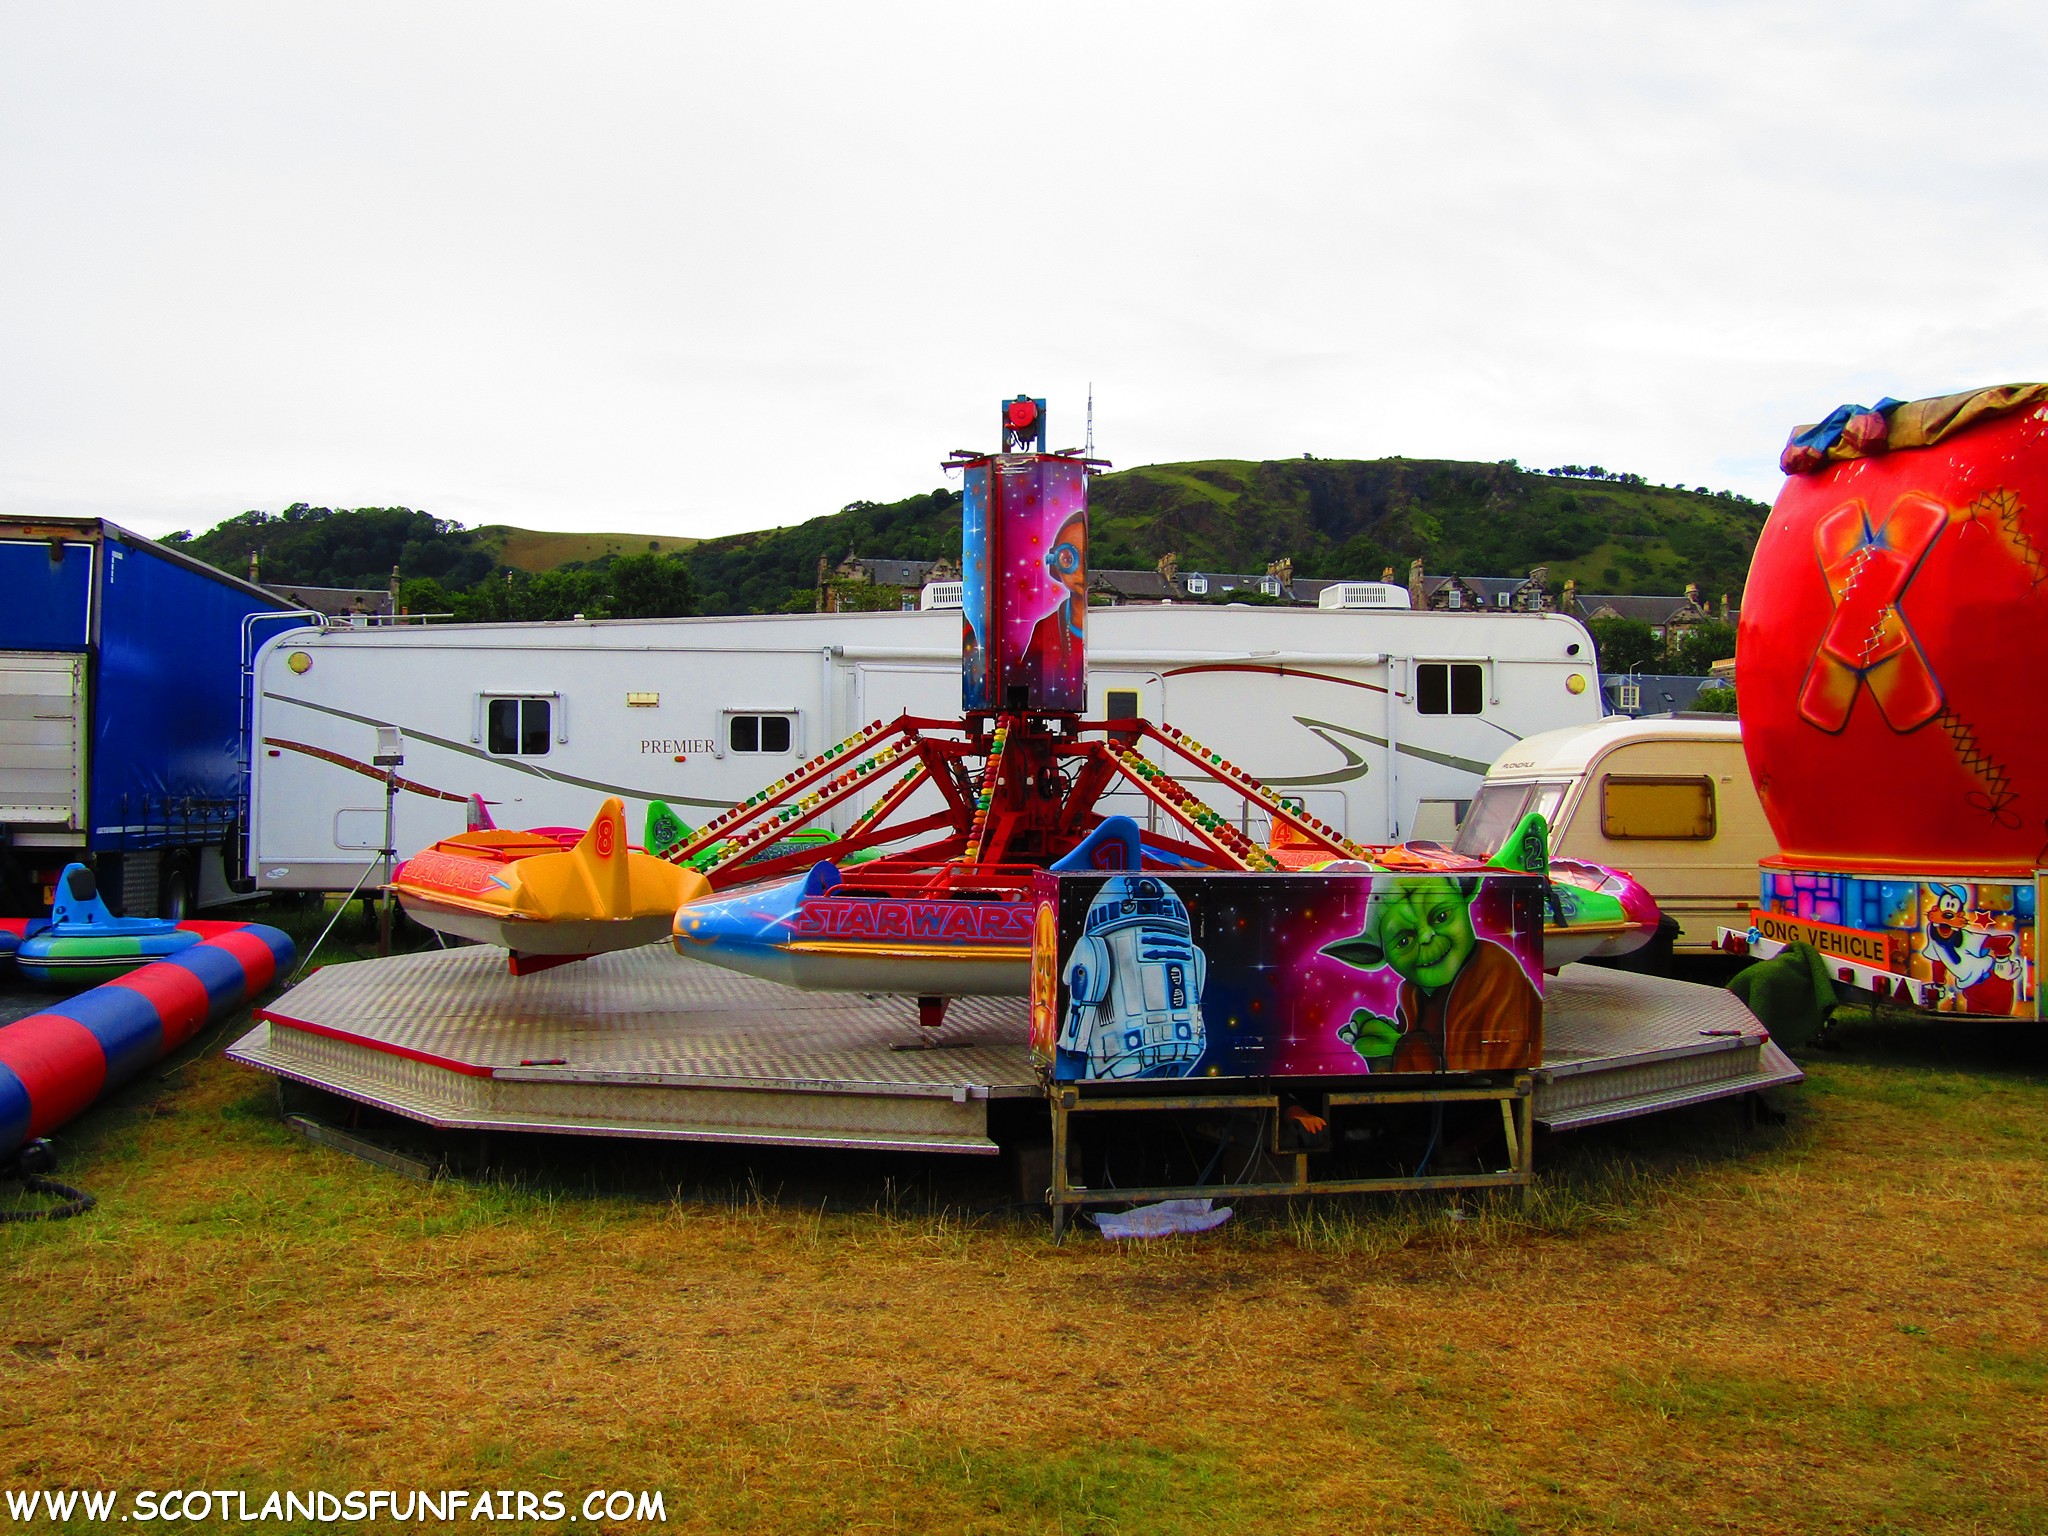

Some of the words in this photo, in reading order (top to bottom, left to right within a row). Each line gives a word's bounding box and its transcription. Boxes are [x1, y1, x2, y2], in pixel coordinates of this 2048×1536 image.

[641, 740, 715, 754] PREMIER
[596, 819, 614, 856] 8
[653, 817, 675, 844] 6
[1274, 822, 1292, 844] 4
[1524, 836, 1544, 870] 2
[1755, 918, 1800, 942] LONG
[1807, 928, 1885, 962] VEHICLE
